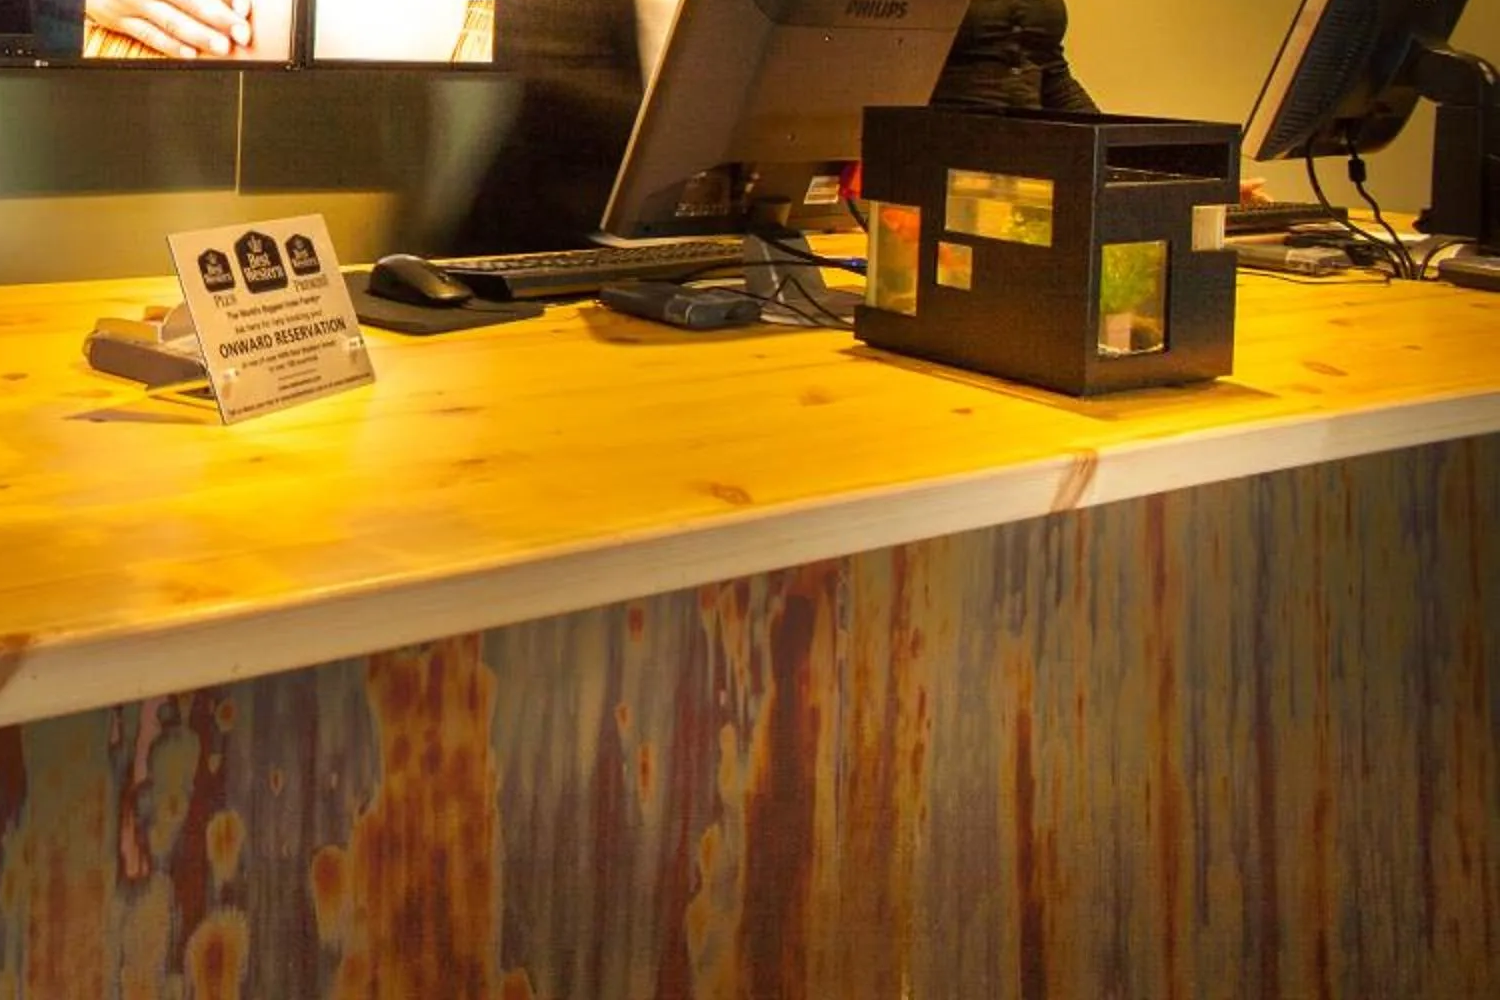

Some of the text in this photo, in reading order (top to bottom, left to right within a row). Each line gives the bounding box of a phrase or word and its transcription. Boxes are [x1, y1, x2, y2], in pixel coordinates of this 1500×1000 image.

[846, 0, 908, 18] PHILIPS
[247, 252, 271, 270] Best
[219, 334, 273, 359] ONWARD
[274, 317, 347, 345] RESERVATION
